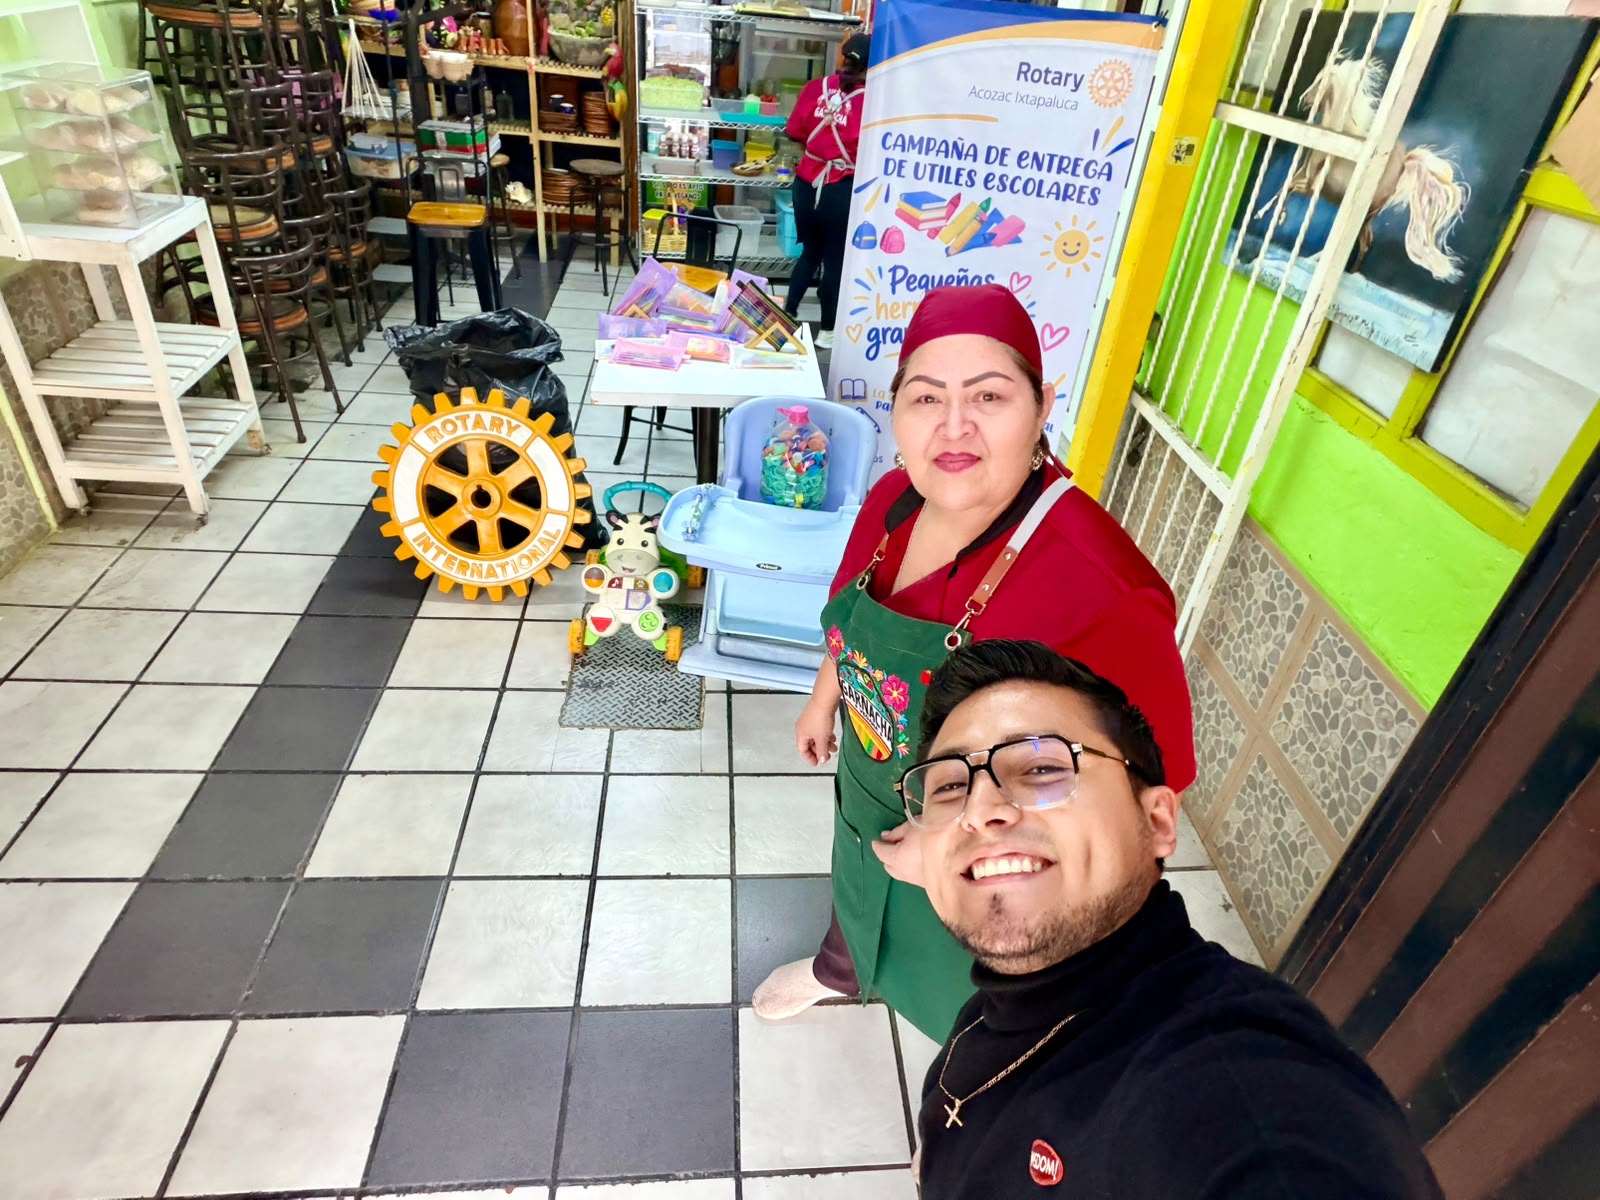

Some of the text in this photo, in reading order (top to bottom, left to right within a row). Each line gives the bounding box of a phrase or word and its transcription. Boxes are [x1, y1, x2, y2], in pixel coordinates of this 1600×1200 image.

[1016, 61, 1085, 93] Rotary
[968, 85, 1079, 111] Acozac Ixtapaluca
[881, 131, 978, 163] CAMPAÑA
[984, 145, 1011, 167] DE
[883, 157, 908, 179] DE
[913, 161, 978, 188] UTILES
[865, 326, 907, 361] gra
[424, 413, 521, 444] ROTARY
[412, 527, 562, 580] INTERNATIONAL
[841, 680, 893, 741] GARNACHA
